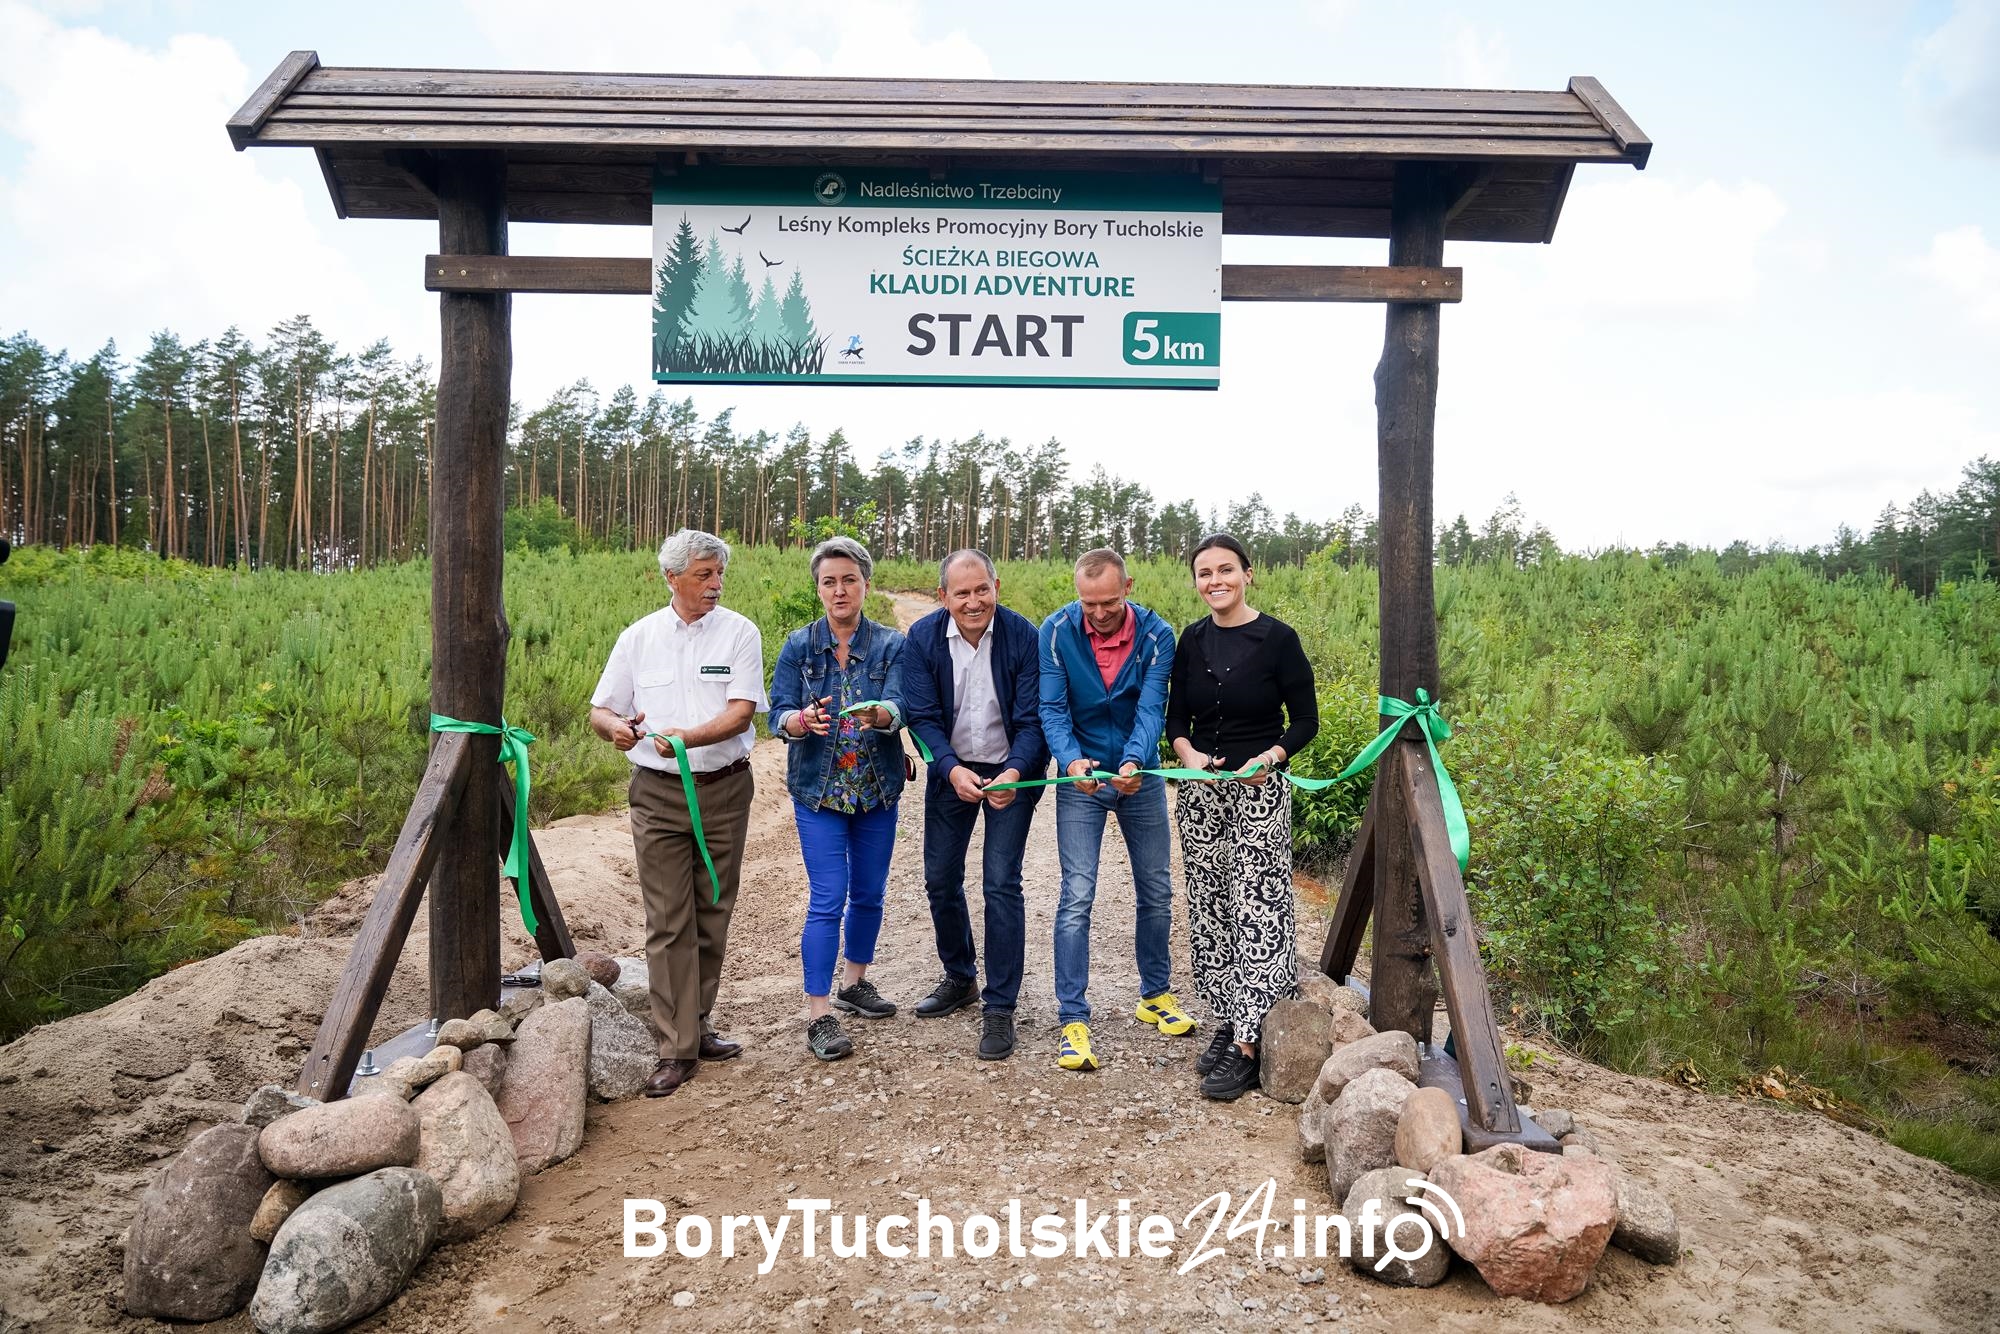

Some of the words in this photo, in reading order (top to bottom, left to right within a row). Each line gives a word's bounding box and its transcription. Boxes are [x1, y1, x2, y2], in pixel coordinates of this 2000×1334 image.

[860, 181, 974, 199] Nadleśnictwo
[979, 183, 1062, 203] Trzebciny
[777, 215, 833, 236] Leśny
[838, 216, 931, 237] Kompleks
[936, 217, 1048, 239] Promocyjny
[1053, 219, 1098, 239] Bory
[1103, 219, 1204, 238] Tucholskie
[902, 244, 990, 267] ŚCIEŻKA
[996, 250, 1099, 268] BIEGOWA
[870, 273, 967, 295] KLAUDI
[974, 275, 1135, 297] ADVENTURE
[906, 312, 1085, 357] START
